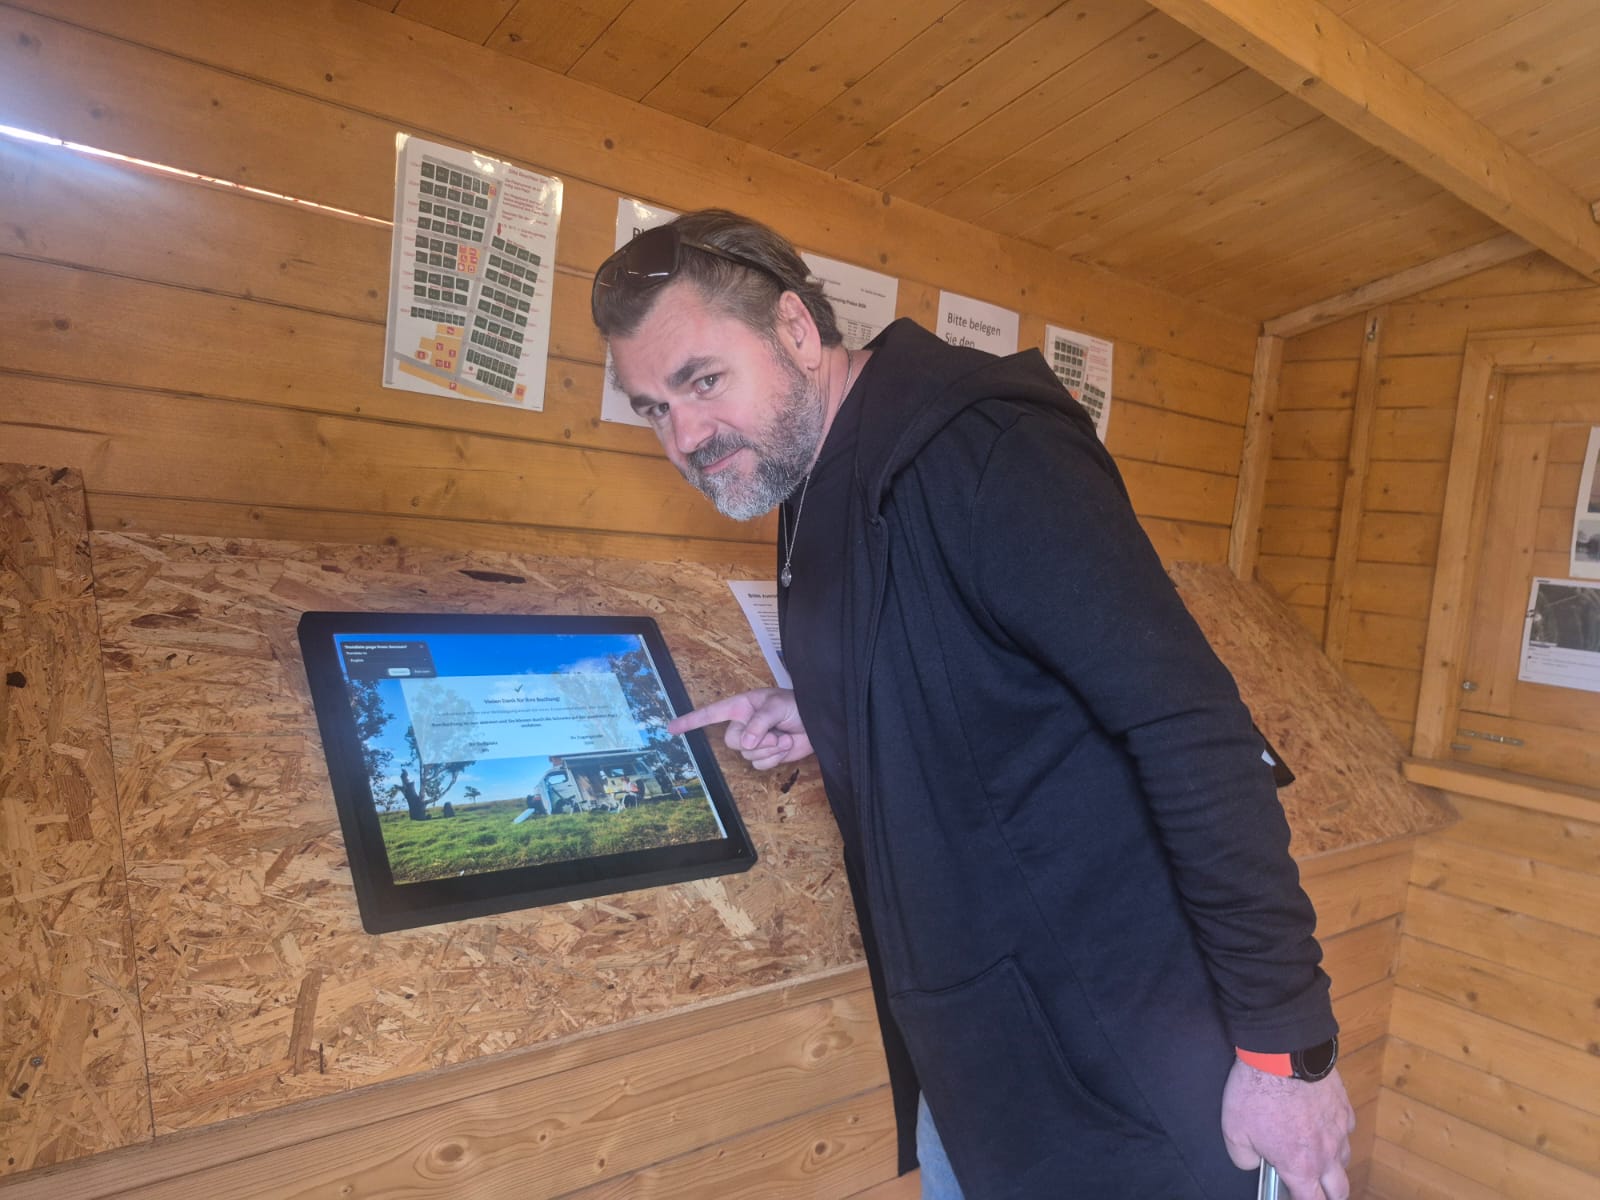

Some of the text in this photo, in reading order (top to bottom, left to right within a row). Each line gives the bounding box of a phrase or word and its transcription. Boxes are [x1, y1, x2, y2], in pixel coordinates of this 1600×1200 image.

[947, 312, 1001, 336] Bitte belegen
[945, 332, 976, 348] Sie den
